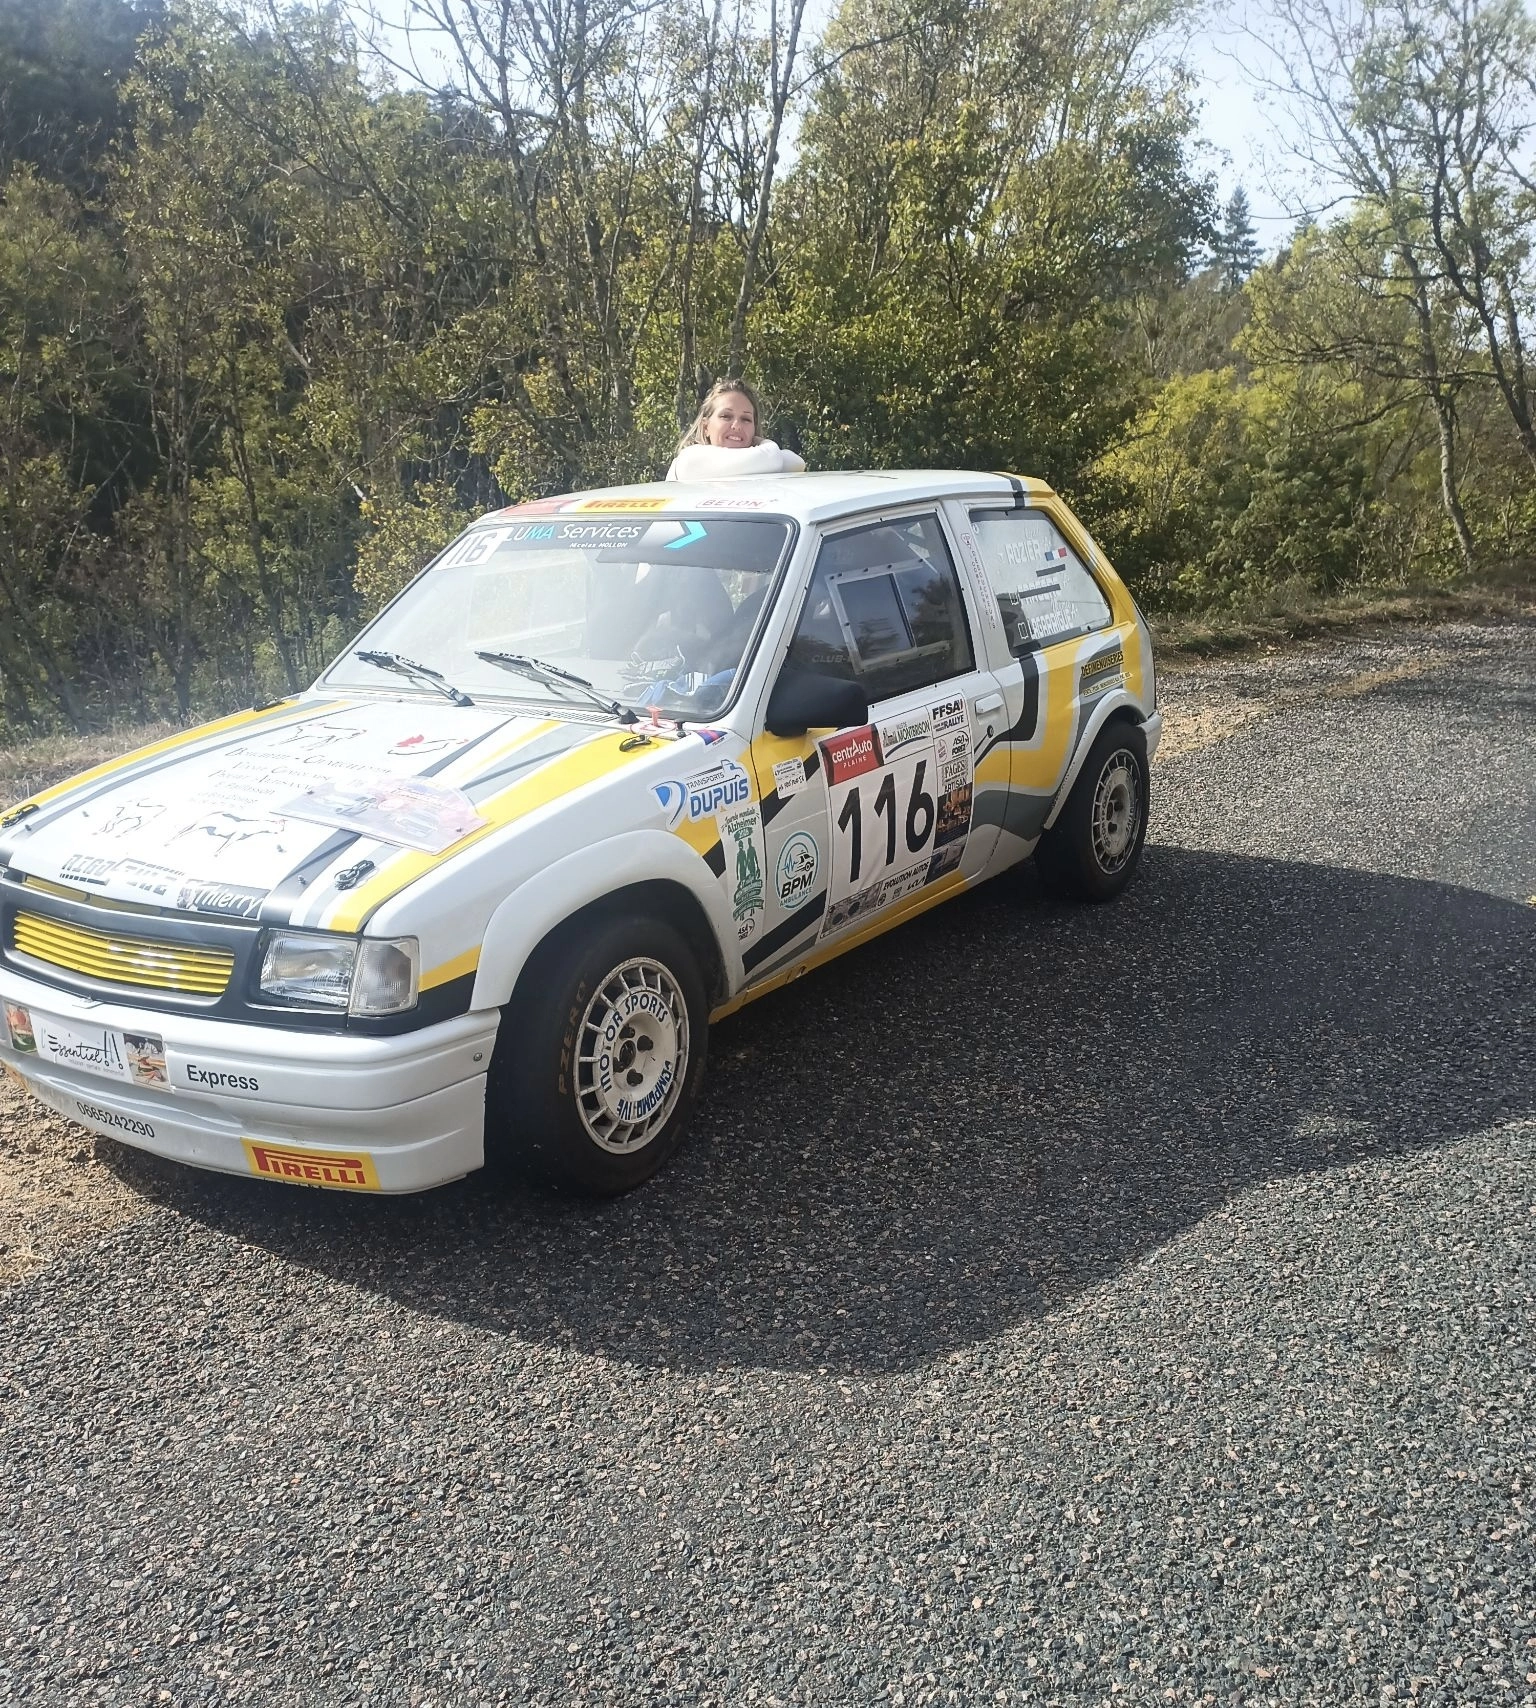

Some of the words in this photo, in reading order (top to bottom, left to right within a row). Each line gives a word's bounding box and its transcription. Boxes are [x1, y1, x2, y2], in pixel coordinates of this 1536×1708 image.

[585, 498, 665, 509] PIRELLI
[557, 523, 642, 539] Services
[446, 531, 497, 566] 116
[932, 700, 961, 720] FFSA
[843, 755, 867, 768] PLAINE
[686, 771, 725, 790] TRANSPORTS
[690, 778, 749, 817] DUPUIS
[727, 816, 757, 836] Alzheimer
[837, 759, 935, 883] 116
[780, 871, 813, 899] BPM
[780, 887, 813, 907] AMBULANCE
[625, 993, 669, 1023] SPORTS
[186, 1064, 259, 1091] Express
[77, 1101, 155, 1138] 0665242290
[252, 1146, 367, 1185] PIRELLI
